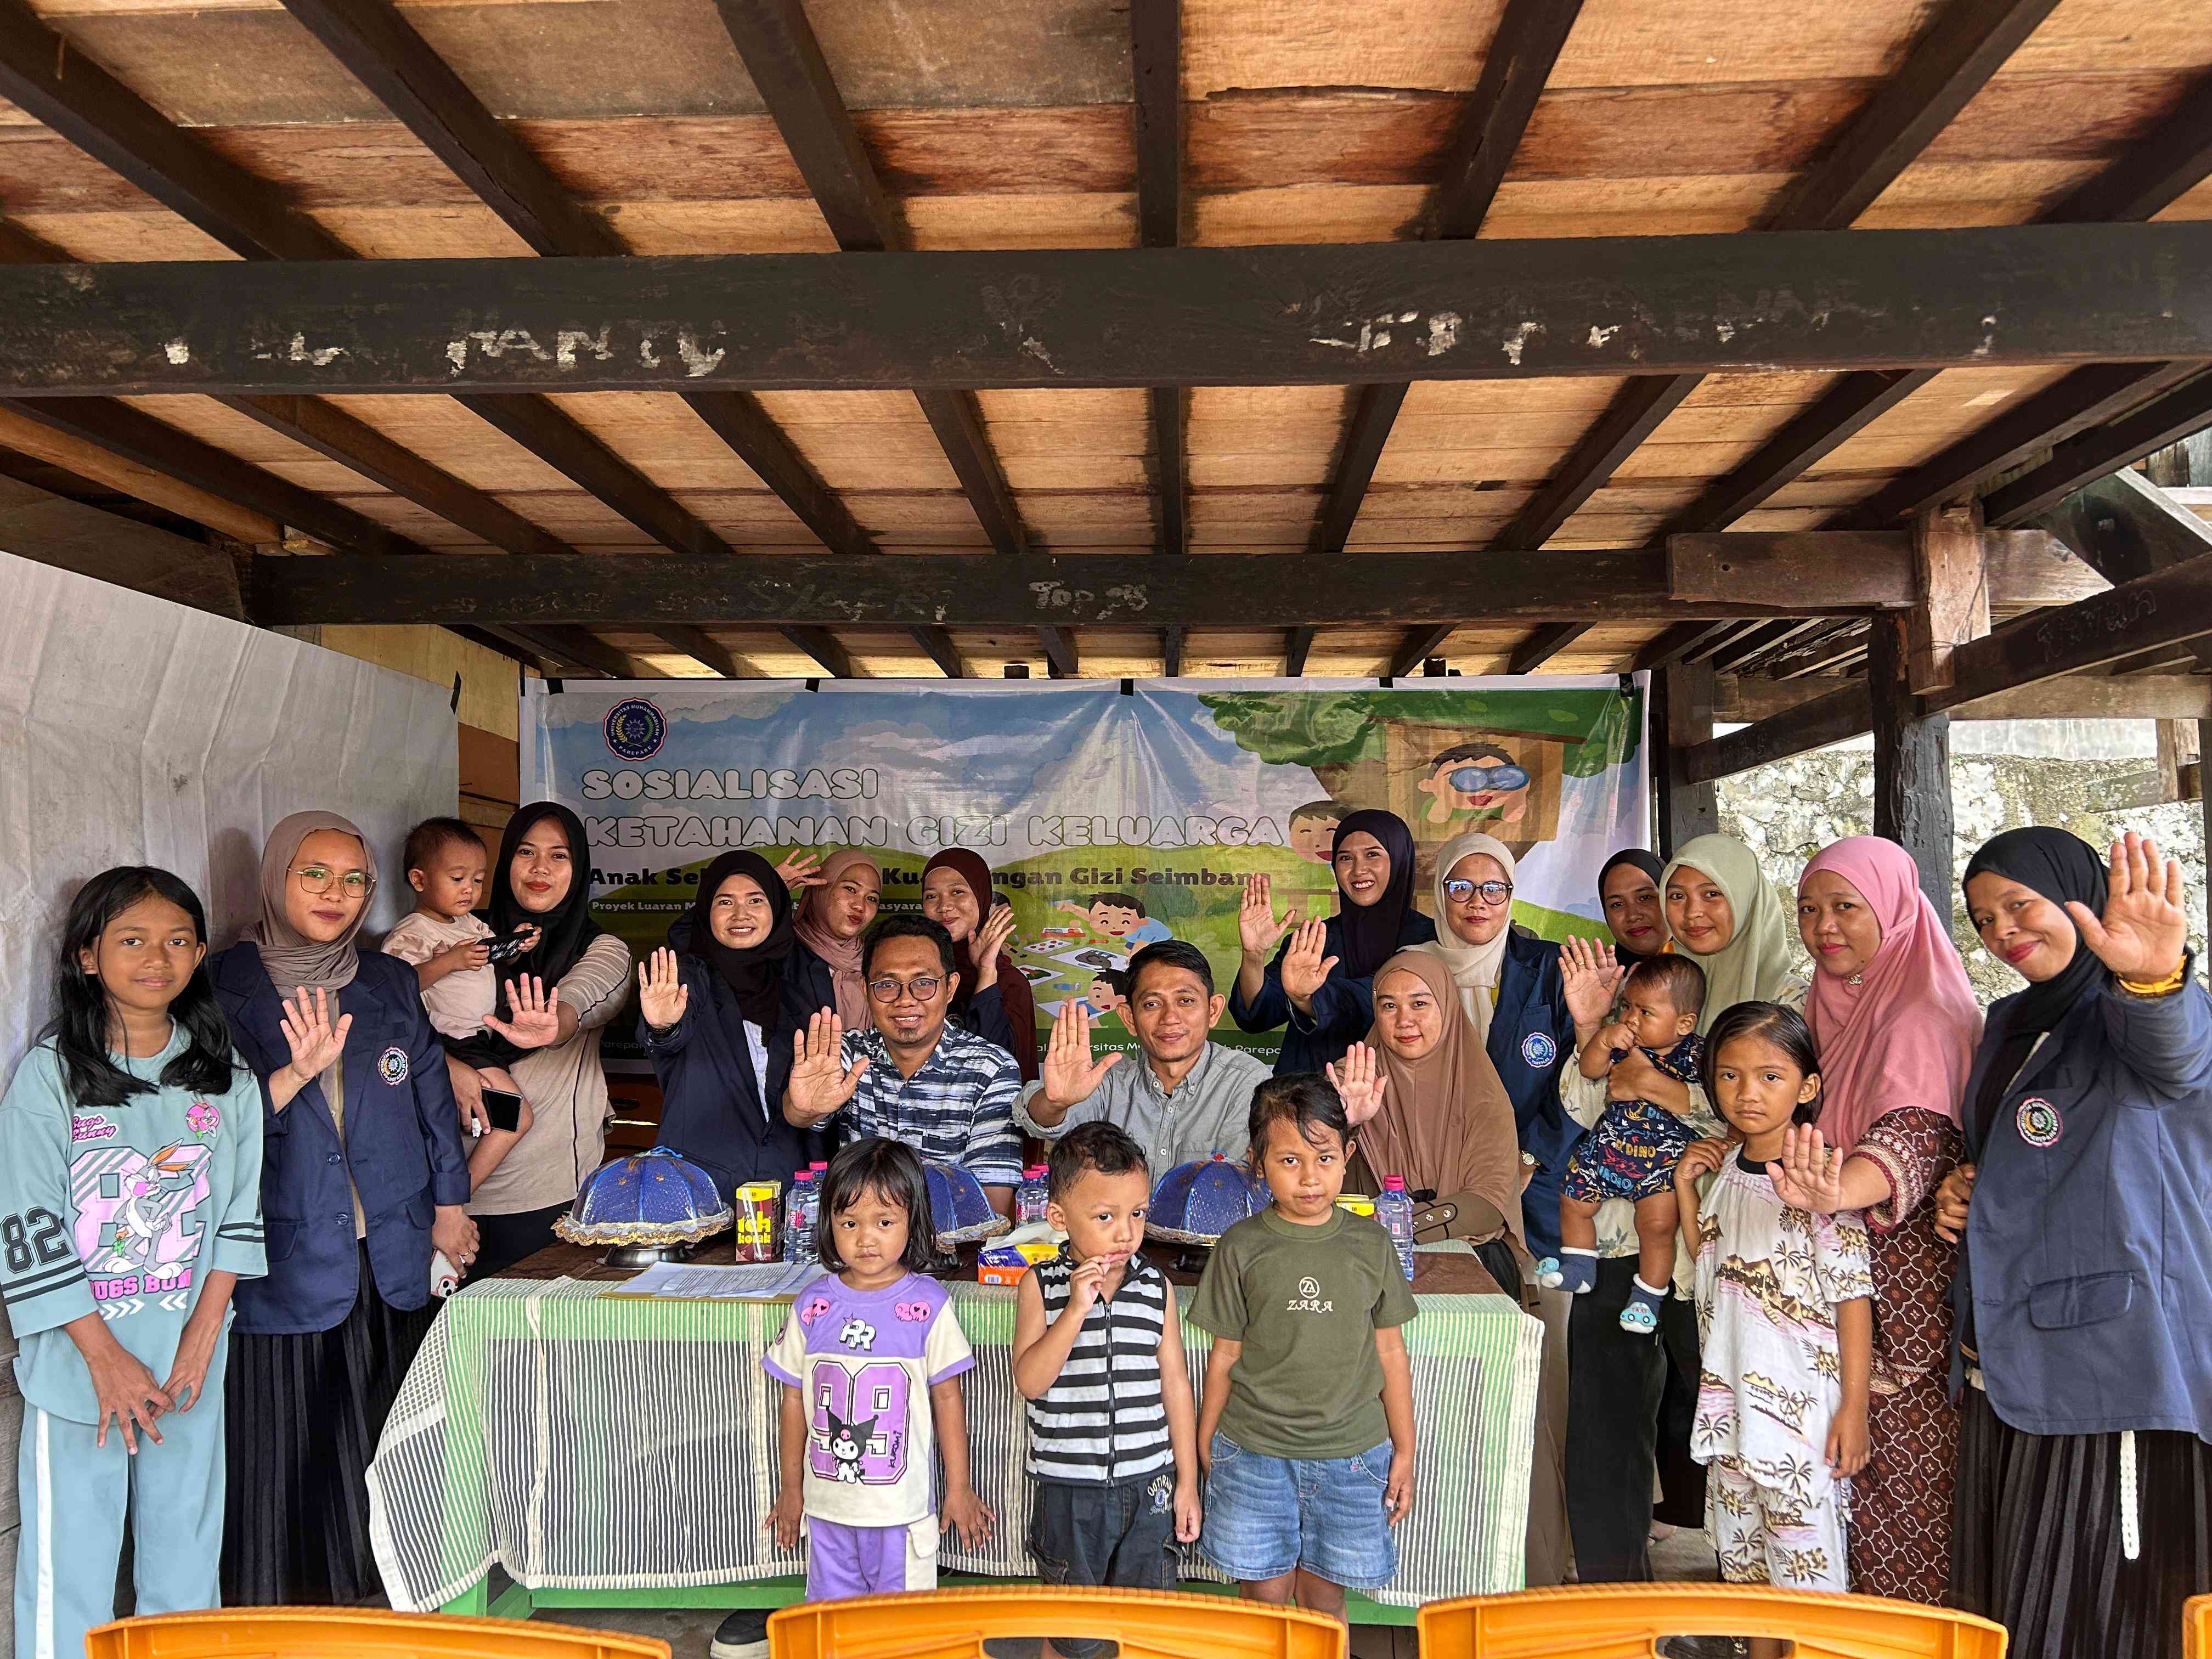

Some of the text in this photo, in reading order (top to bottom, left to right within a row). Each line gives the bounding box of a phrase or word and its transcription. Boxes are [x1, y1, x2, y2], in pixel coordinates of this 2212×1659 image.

[610, 704, 659, 736] UNIVERSITAS MUHAMMADIYAH
[619, 746, 652, 755] PAREPARE
[582, 768, 878, 799] SOSIALISASI
[584, 815, 1284, 847] KETAHANAN GIZI KELUARGA
[590, 868, 658, 885] Anak
[882, 868, 923, 885] Ku
[991, 871, 1062, 889] ngan
[1070, 867, 1123, 884] Gizi
[592, 901, 634, 911] Proyek
[638, 901, 681, 911] Luaran
[878, 903, 922, 913] asyara
[1625, 1143, 1656, 1158] DINO
[1, 1206, 72, 1273] 82
[1286, 1299, 1333, 1313] ZARA
